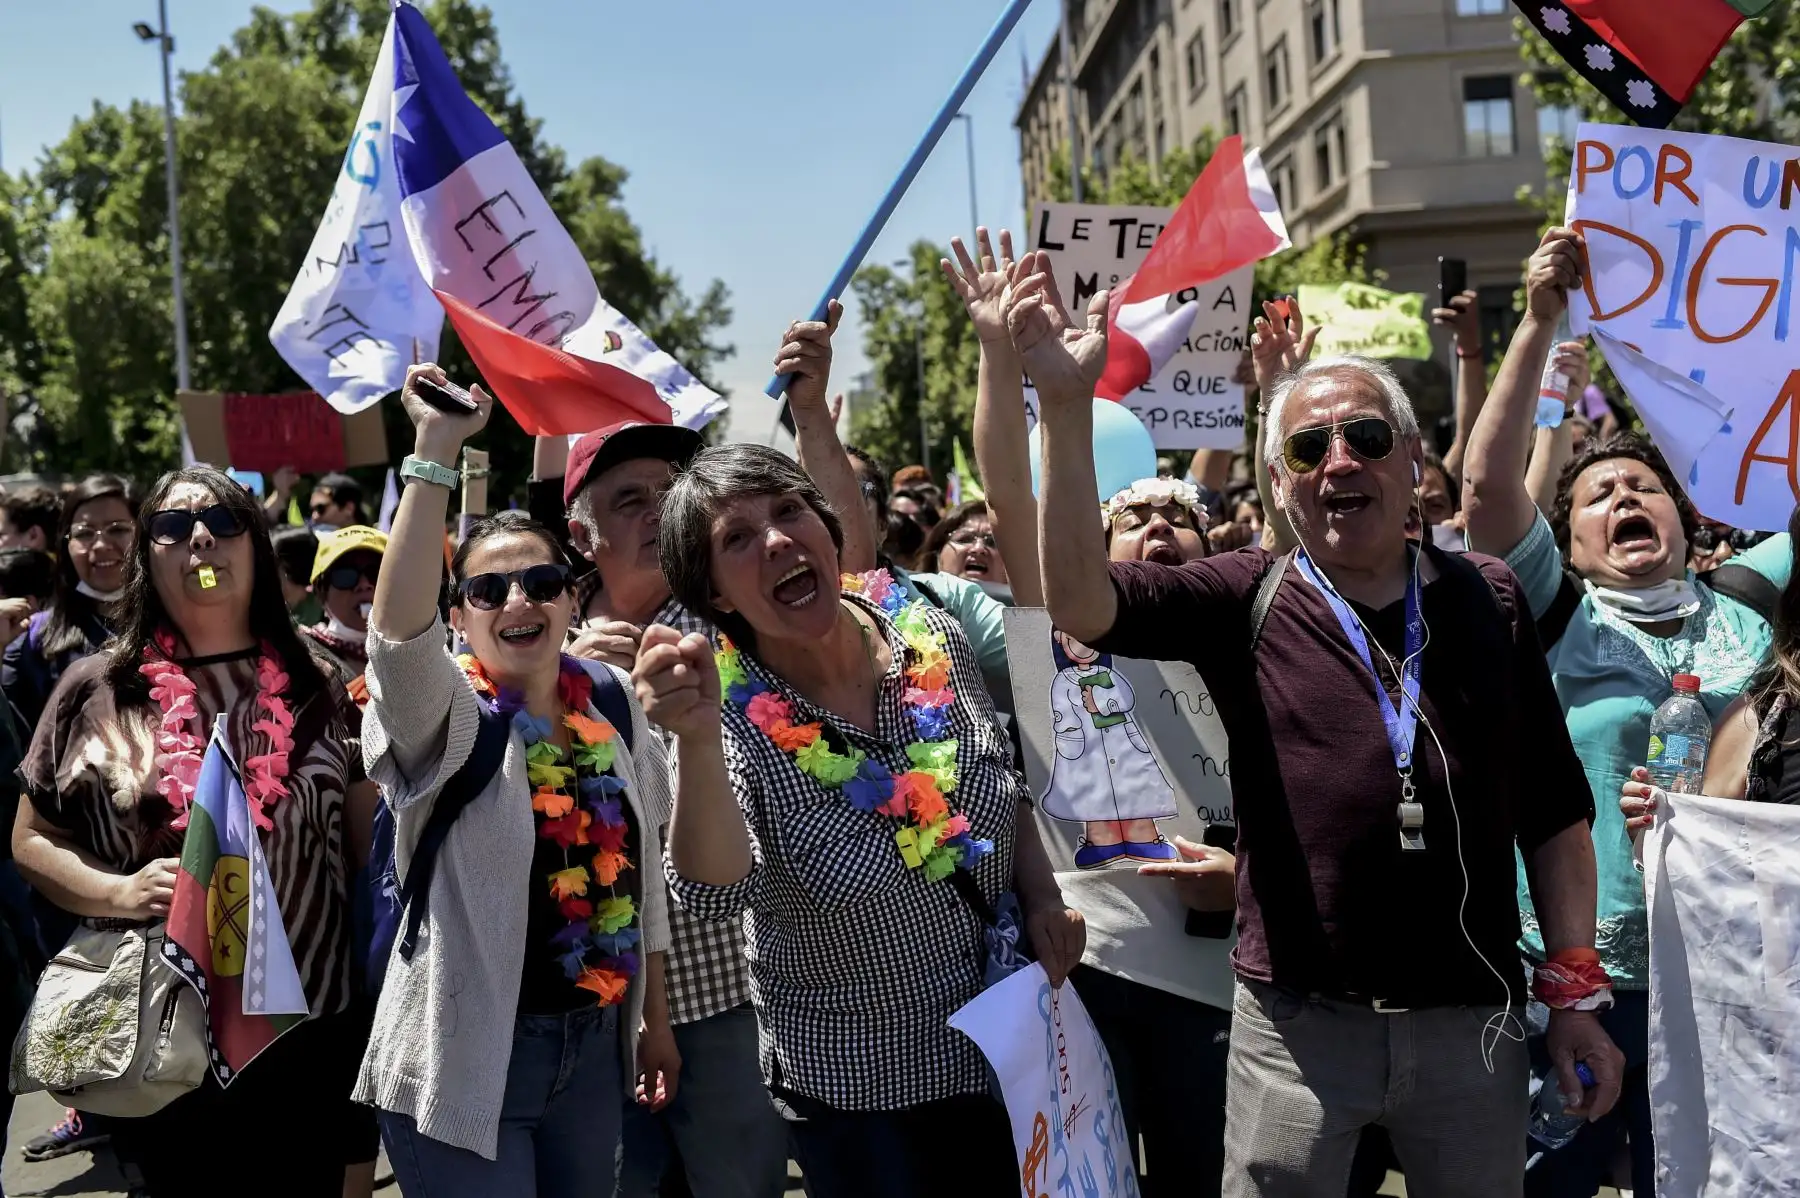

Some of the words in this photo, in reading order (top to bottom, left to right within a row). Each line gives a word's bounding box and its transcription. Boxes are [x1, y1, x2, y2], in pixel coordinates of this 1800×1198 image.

[1577, 140, 1700, 206] POR
[1037, 210, 1092, 251] LE
[1173, 369, 1228, 396] QUE
